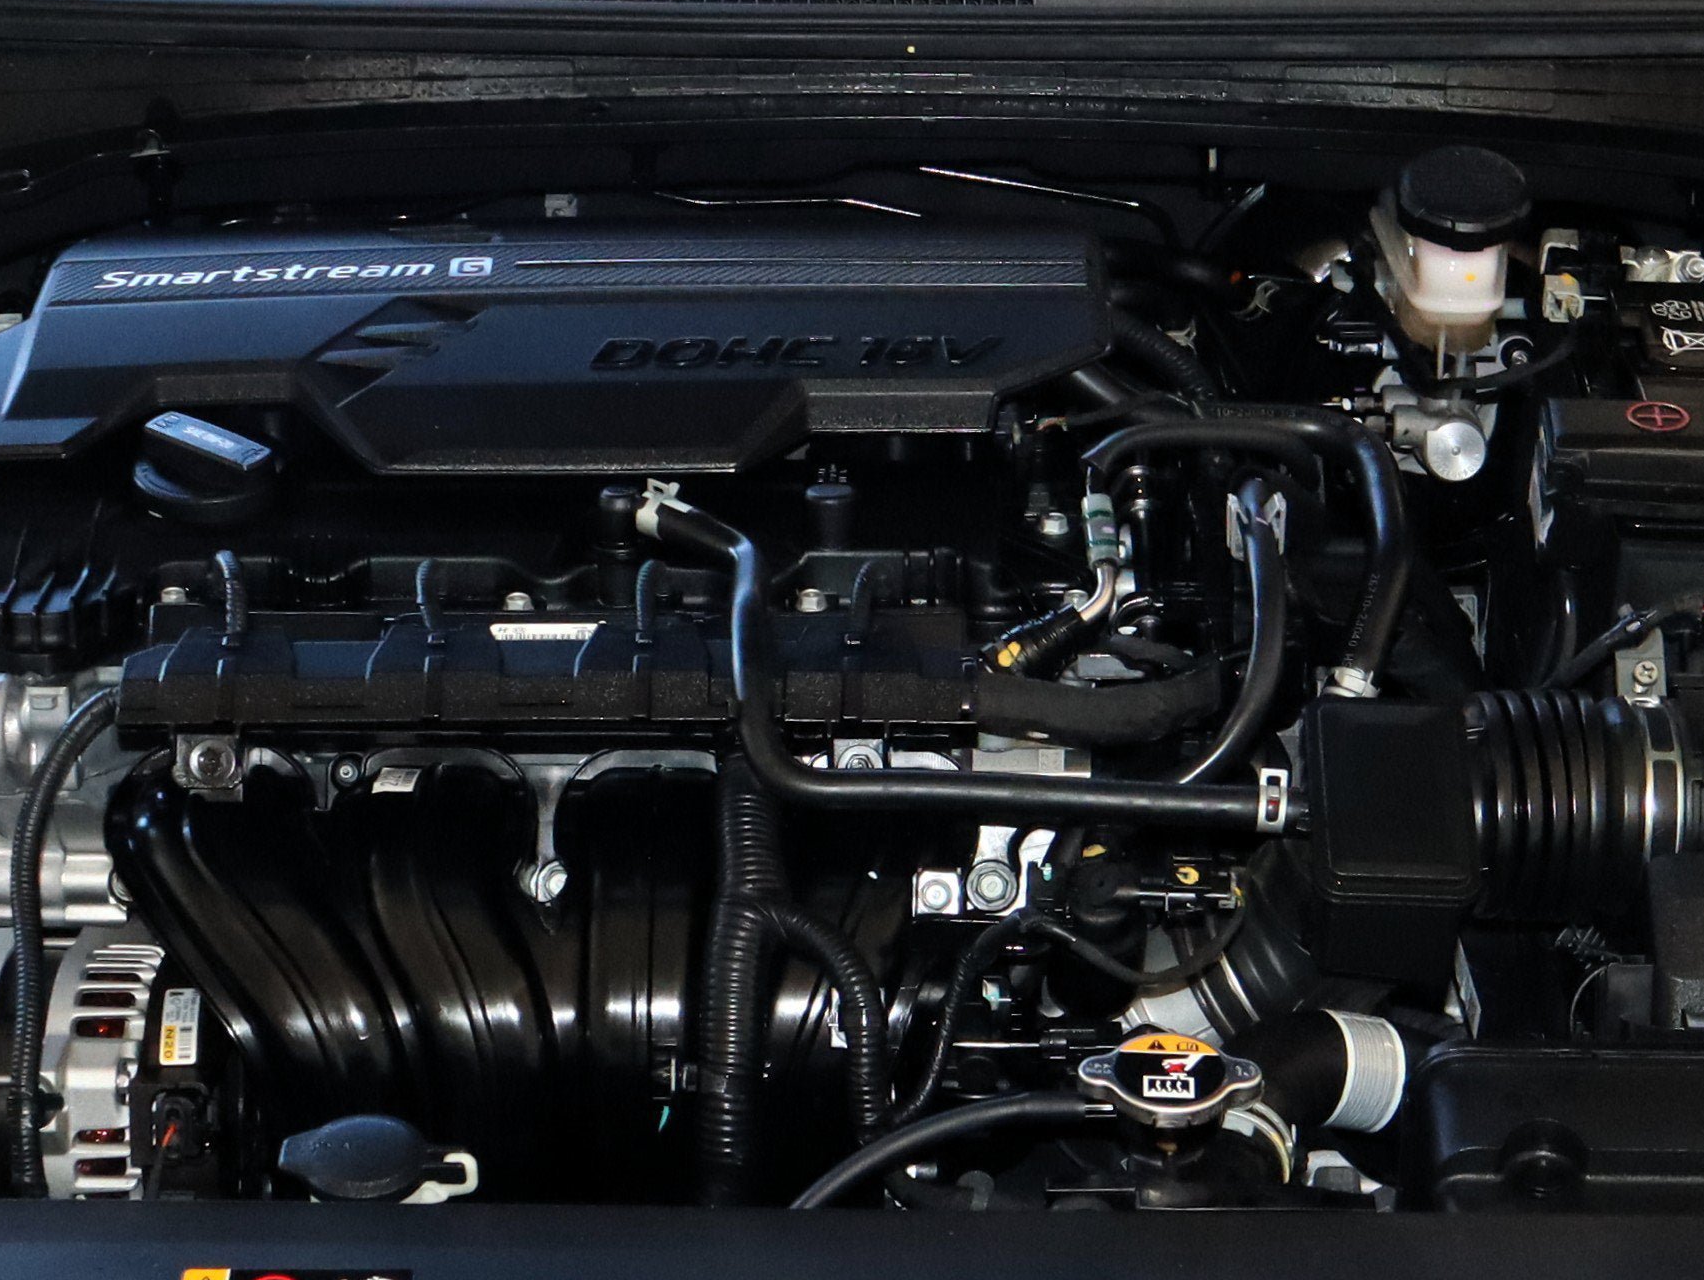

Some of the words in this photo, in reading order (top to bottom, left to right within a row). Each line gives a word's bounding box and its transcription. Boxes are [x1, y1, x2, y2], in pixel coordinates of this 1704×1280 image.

[94, 259, 436, 289] Smartstream
[451, 258, 490, 276] G
[590, 335, 840, 372] DOHC
[859, 335, 1004, 368] 16V
